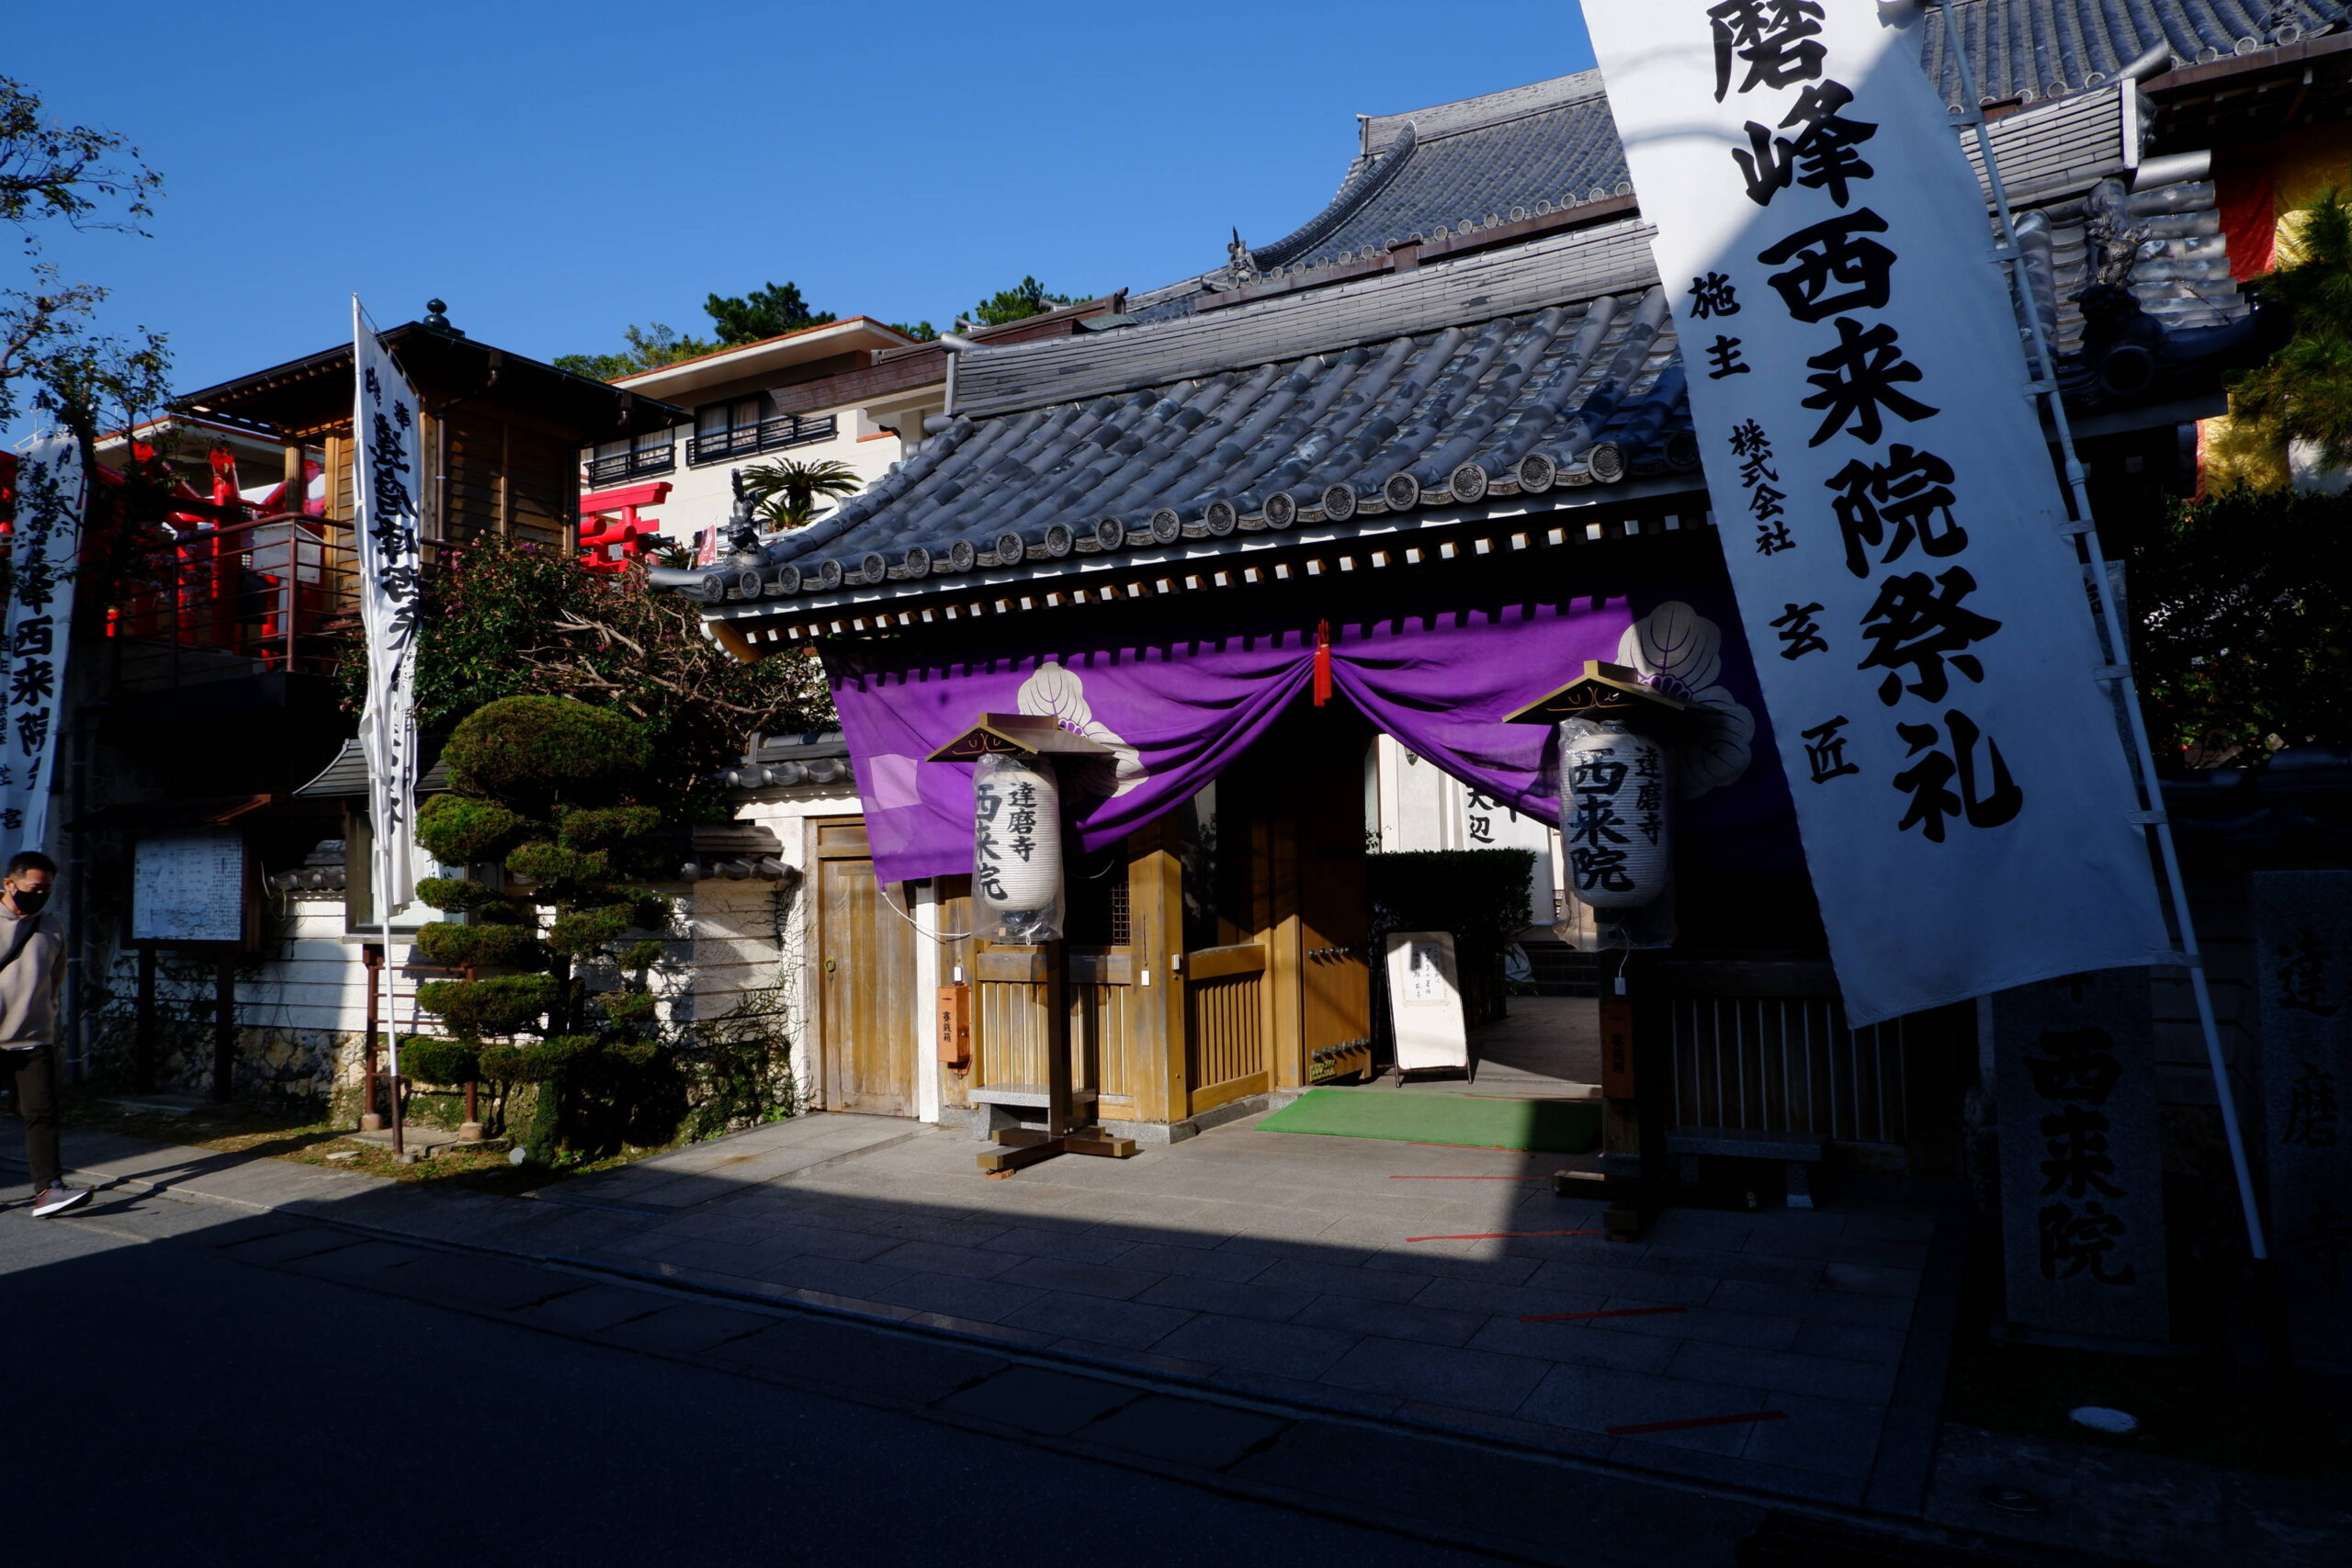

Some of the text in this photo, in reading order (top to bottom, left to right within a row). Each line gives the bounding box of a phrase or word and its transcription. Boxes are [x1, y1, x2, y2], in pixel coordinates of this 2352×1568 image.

[1706, 0, 2023, 843] 磨峰西来院祭礼
[1688, 272, 1860, 784] 施主 株式会社 玄匠
[1007, 782, 1037, 863] 達磨寺
[1567, 748, 1635, 892] 西来院
[1634, 746, 1663, 845] 達磨寺
